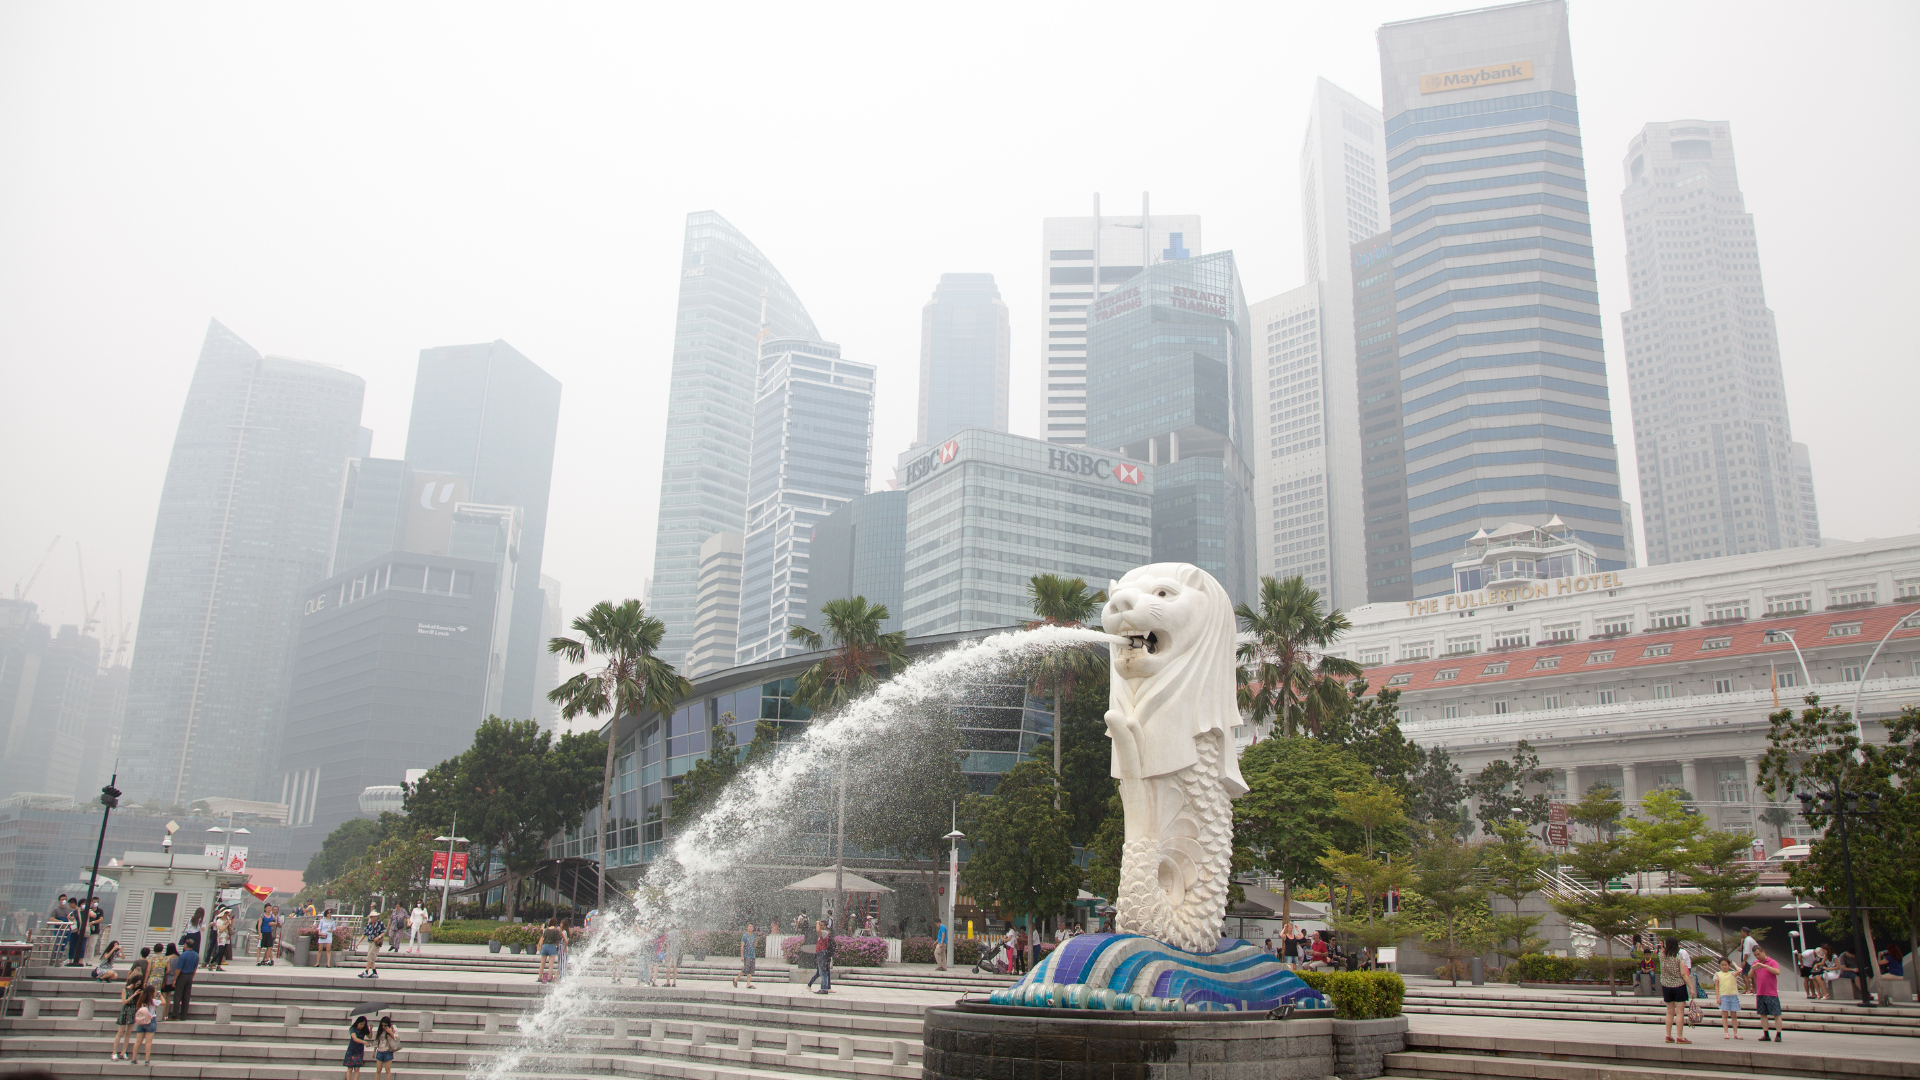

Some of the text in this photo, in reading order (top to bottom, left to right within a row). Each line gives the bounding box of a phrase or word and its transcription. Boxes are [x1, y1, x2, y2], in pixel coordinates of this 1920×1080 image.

[1444, 65, 1523, 86] Maybank
[683, 267, 707, 278] ANZ
[1094, 286, 1140, 311] STRAITS
[1170, 296, 1227, 317] TRADING
[1173, 286, 1227, 305] STRAITS
[1094, 297, 1142, 322] TRADING
[905, 448, 940, 486] HSBC
[1048, 448, 1111, 480] HSBC
[1406, 571, 1623, 616] THE FULLERTON HOTEL
